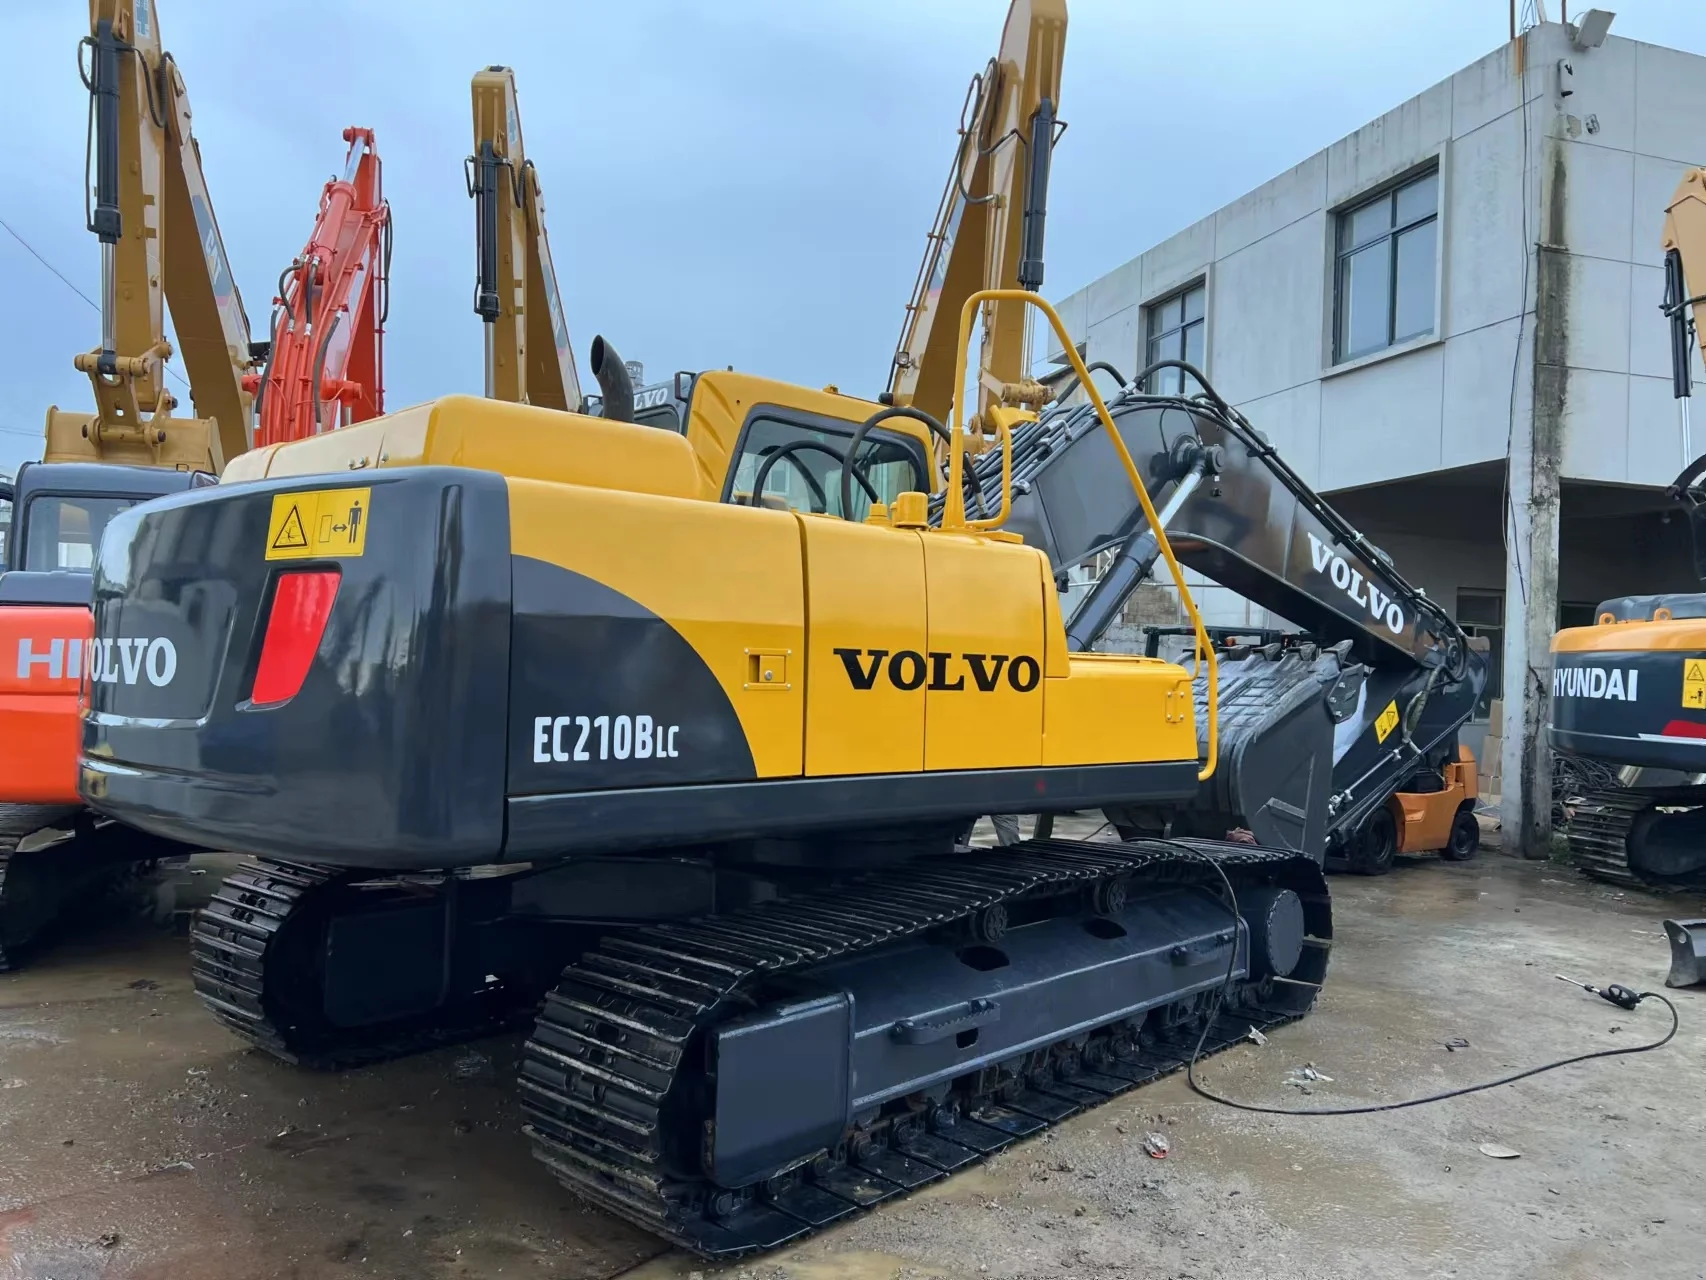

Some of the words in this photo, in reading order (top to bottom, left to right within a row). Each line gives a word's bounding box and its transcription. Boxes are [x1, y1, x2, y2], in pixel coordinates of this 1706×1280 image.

[205, 228, 222, 285] CAT
[633, 387, 668, 411] LVO
[1307, 531, 1404, 634] VOLVO
[17, 638, 82, 679] HI
[833, 647, 1041, 692] VOLVO
[1553, 667, 1638, 701] HYUNDAI
